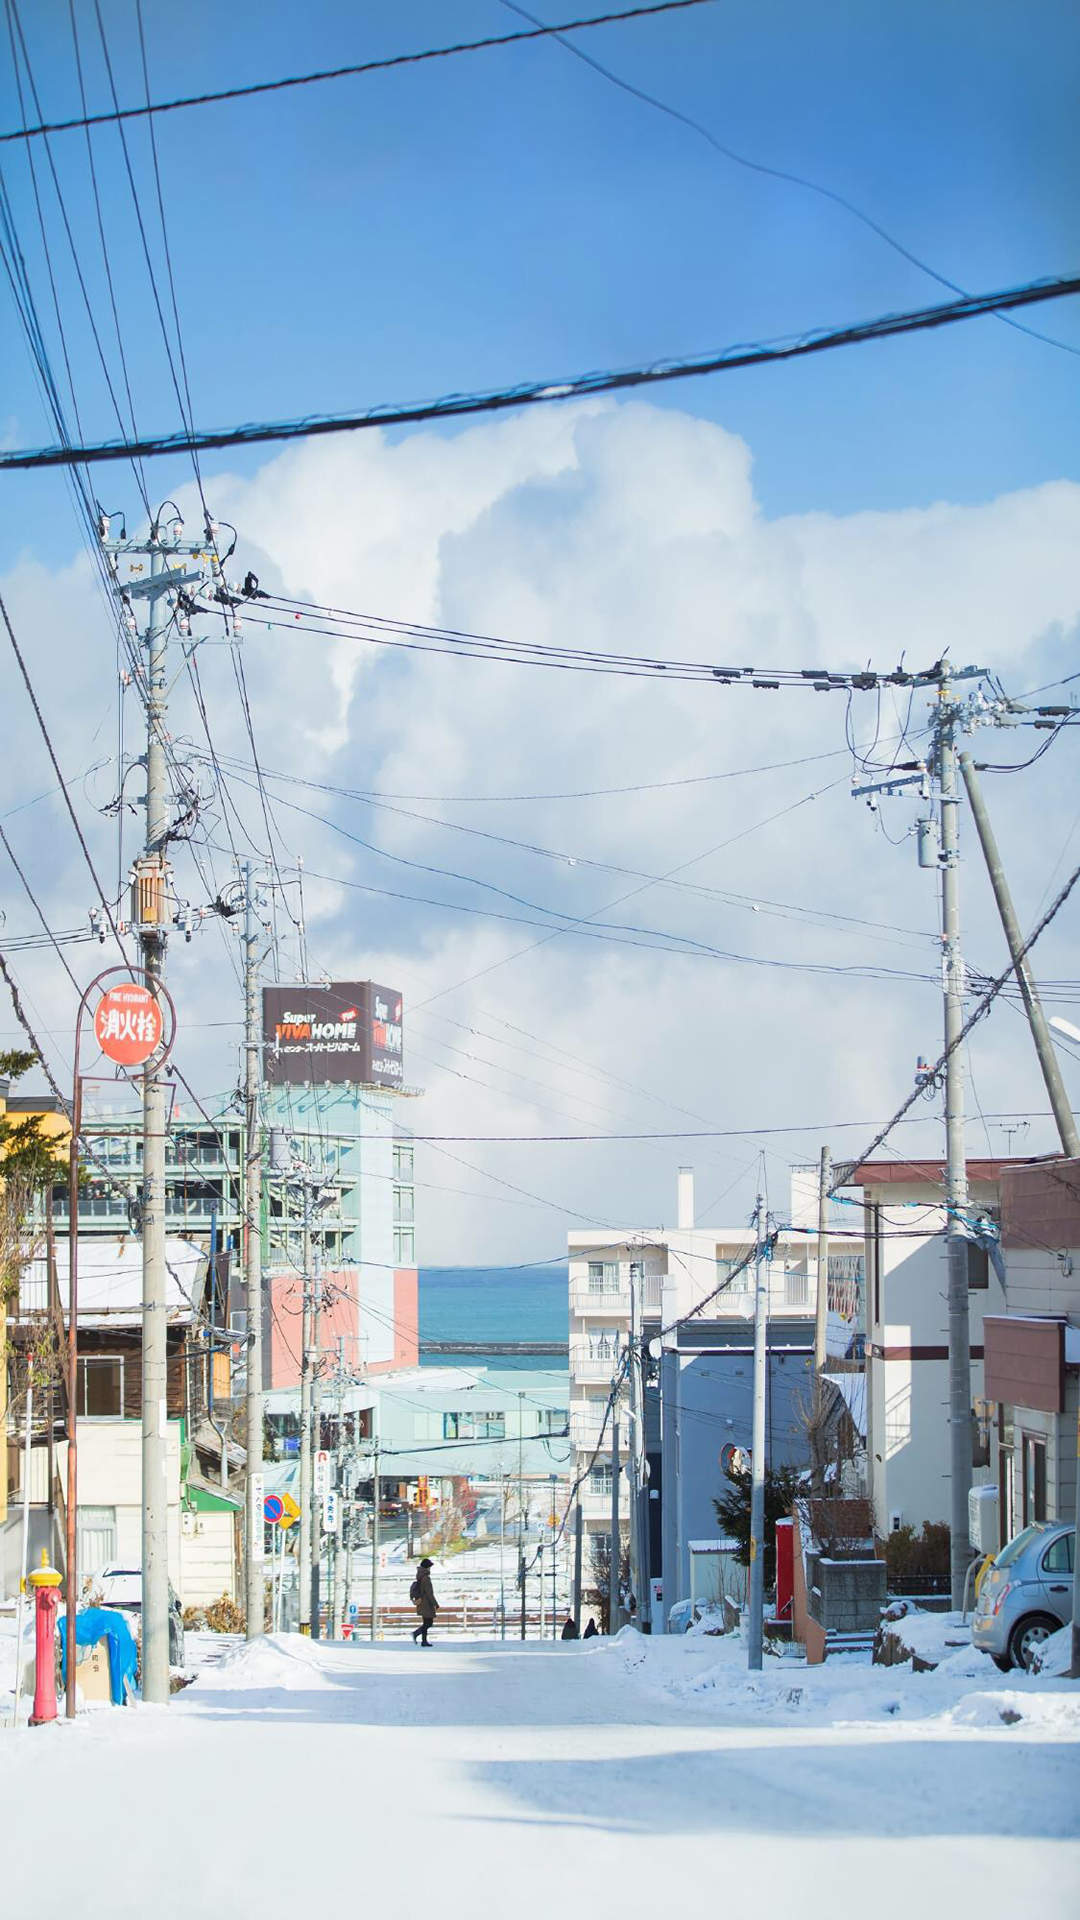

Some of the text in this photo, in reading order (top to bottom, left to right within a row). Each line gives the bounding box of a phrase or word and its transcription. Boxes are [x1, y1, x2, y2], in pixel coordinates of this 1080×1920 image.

[99, 1008, 156, 1042] 消火栓
[282, 1011, 317, 1025] Super
[311, 1022, 357, 1040] HOME
